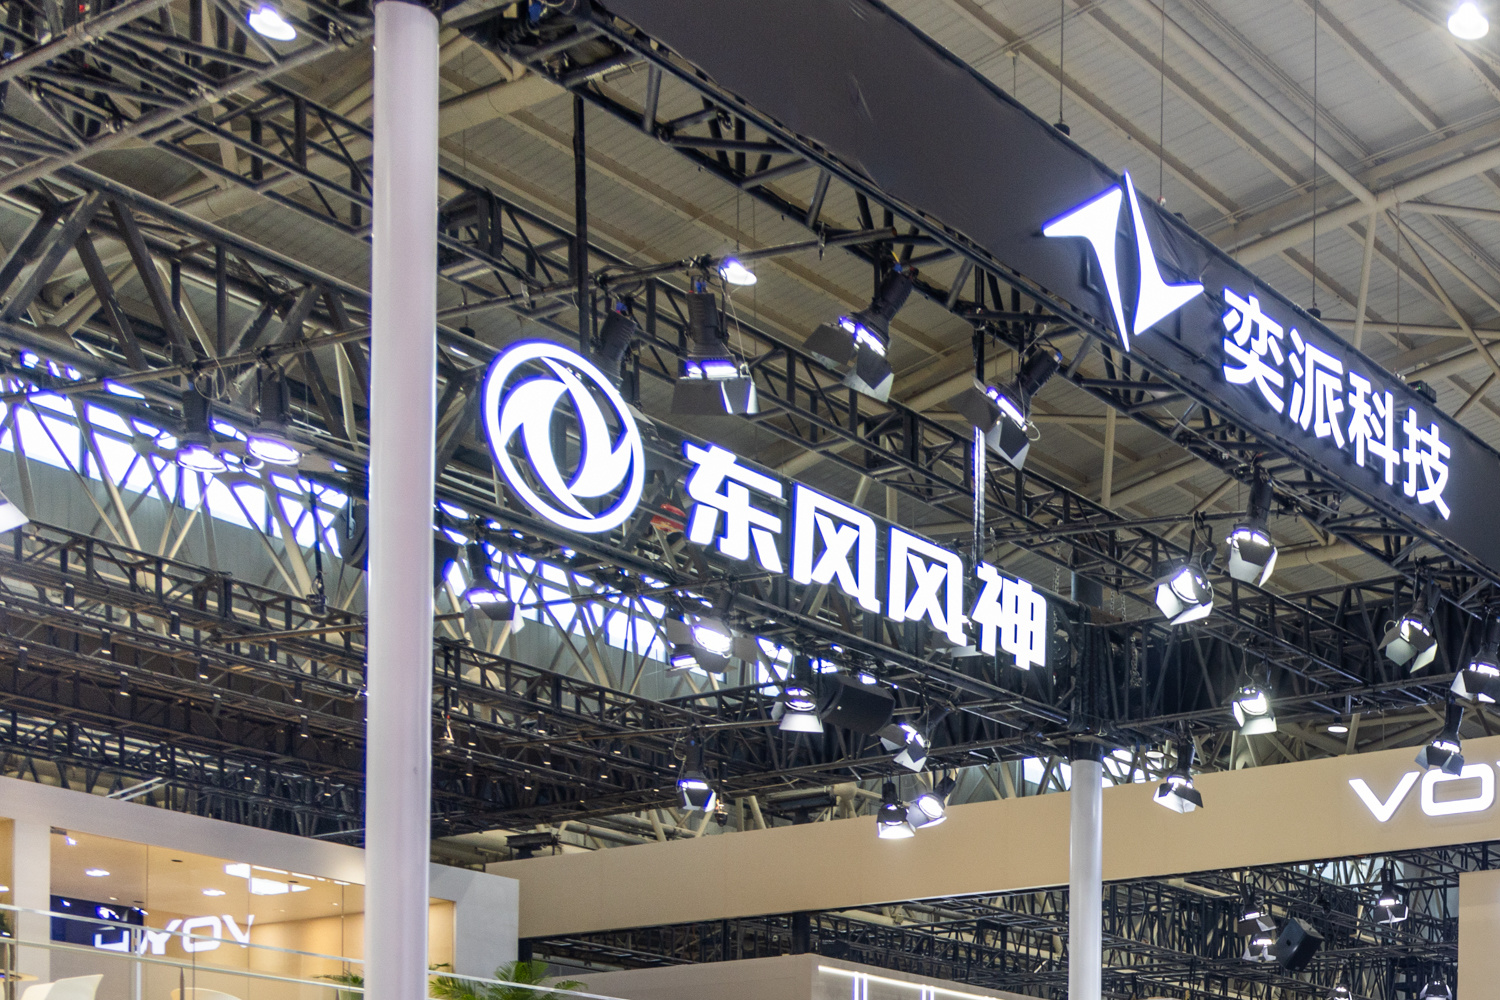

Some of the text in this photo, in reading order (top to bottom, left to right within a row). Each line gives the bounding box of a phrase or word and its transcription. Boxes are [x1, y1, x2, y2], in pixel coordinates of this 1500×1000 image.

[1222, 287, 1451, 521] 奕派科技
[684, 441, 1047, 670] 东风风神
